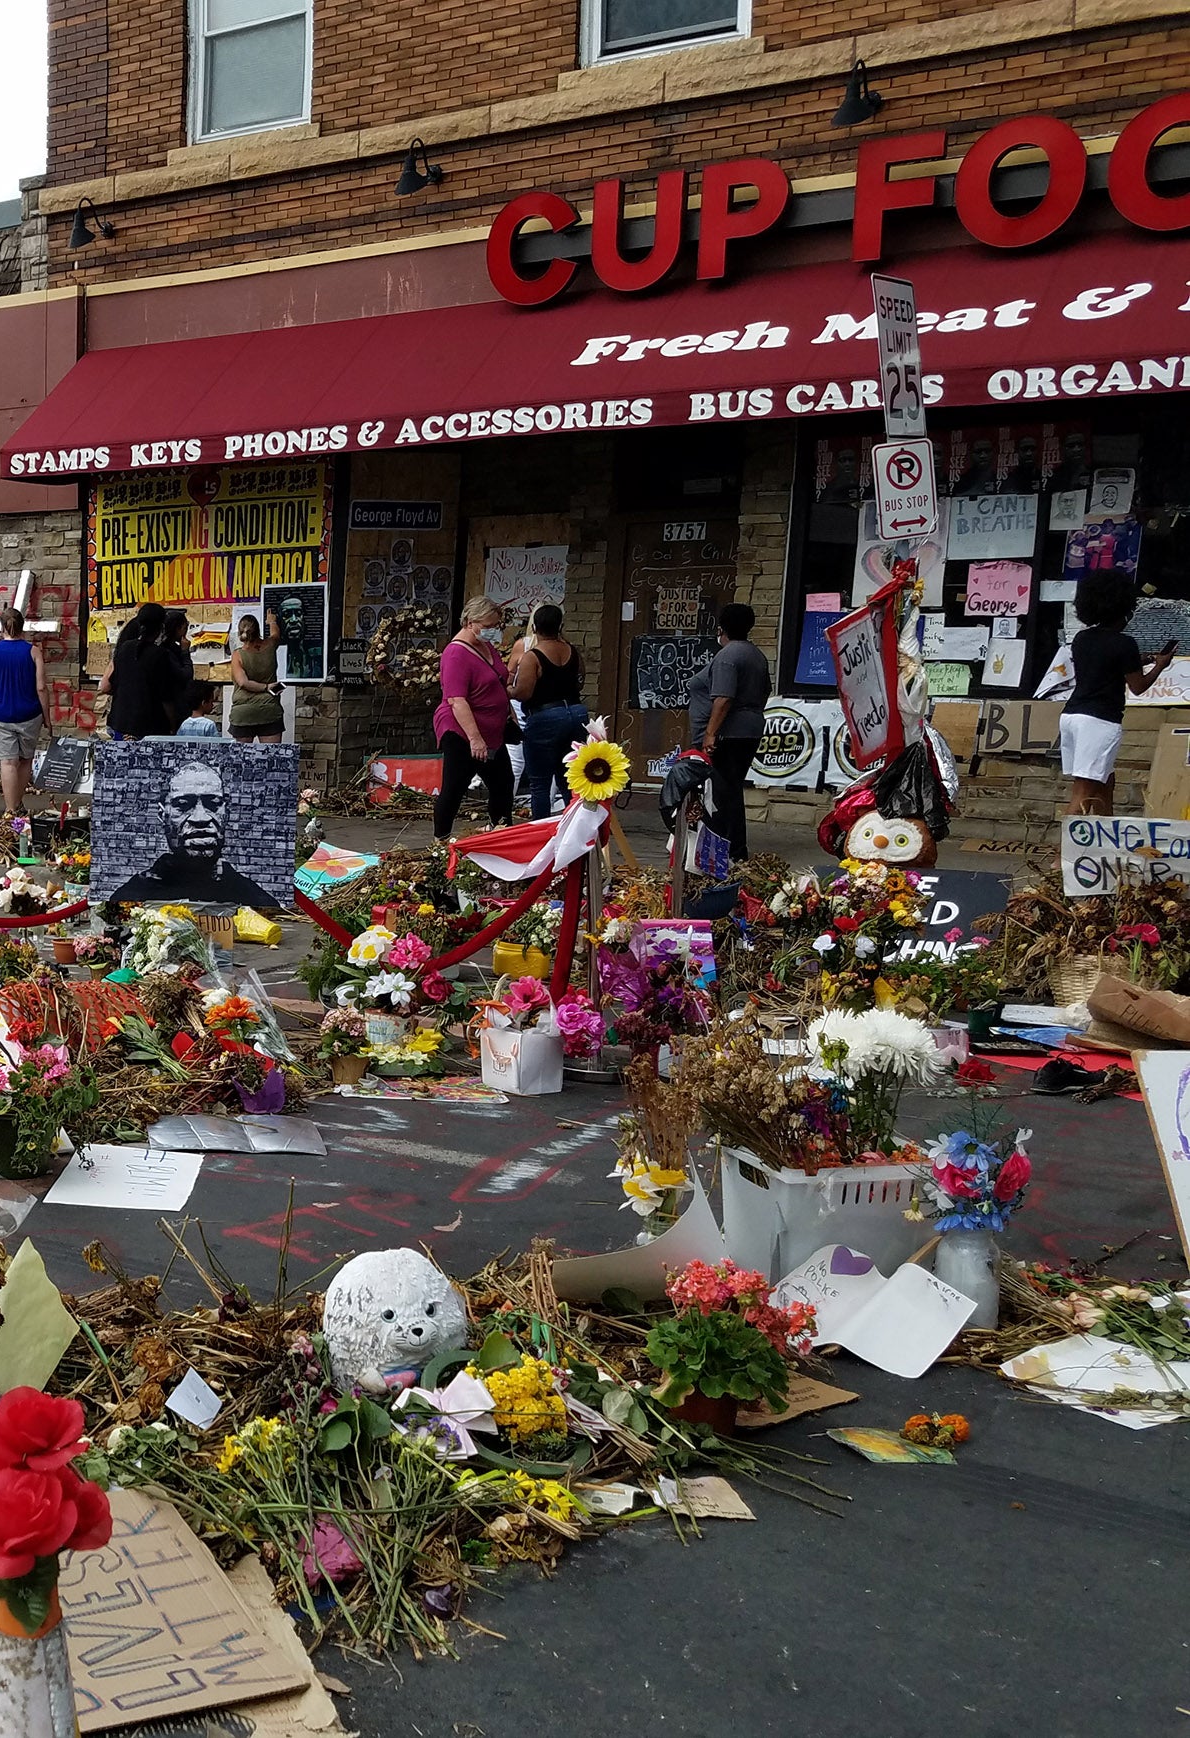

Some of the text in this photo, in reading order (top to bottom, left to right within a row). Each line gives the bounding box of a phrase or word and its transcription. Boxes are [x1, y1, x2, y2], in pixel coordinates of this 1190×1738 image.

[486, 158, 790, 306] CUP
[879, 296, 914, 325] SPEED
[570, 282, 1152, 366] Fresh Meat &
[886, 332, 913, 355] LIMIT
[885, 364, 922, 421] 25
[10, 446, 111, 476] STAMPS
[130, 439, 202, 467] KEYS
[224, 425, 348, 459] PHONES
[357, 421, 385, 448] &
[394, 397, 654, 445] ACCESSORIES
[688, 387, 774, 421] BUS
[786, 374, 944, 416] CARS
[884, 494, 929, 512] BUS STOP
[956, 495, 1030, 516] I CANT
[354, 507, 440, 526] George Floyd Av
[956, 513, 1036, 535] BREATHE
[101, 500, 317, 558] PRE-EXISTING CONDITION:
[664, 522, 705, 541] 3757
[491, 550, 514, 571] No
[102, 562, 149, 607] BEING
[154, 556, 205, 602] BLACK
[210, 555, 228, 599] IN
[232, 550, 313, 598] AMERICA
[488, 570, 511, 593] No
[660, 588, 699, 600] JUSTICE
[967, 592, 1018, 616] George
[668, 602, 687, 613] FOR
[657, 614, 697, 628] GEORGE
[676, 637, 714, 671] Justi
[763, 716, 805, 736] MOJ
[850, 696, 887, 747] Freedo
[763, 752, 797, 765] Radio
[313, 771, 327, 782] NOT
[293, 876, 314, 890] IGHT
[198, 915, 232, 932] FLOYD
[816, 1259, 828, 1278] NO
[804, 1264, 840, 1298] POLICE
[112, 1505, 298, 1687] MATTER
[56, 1544, 207, 1711] LIVES
